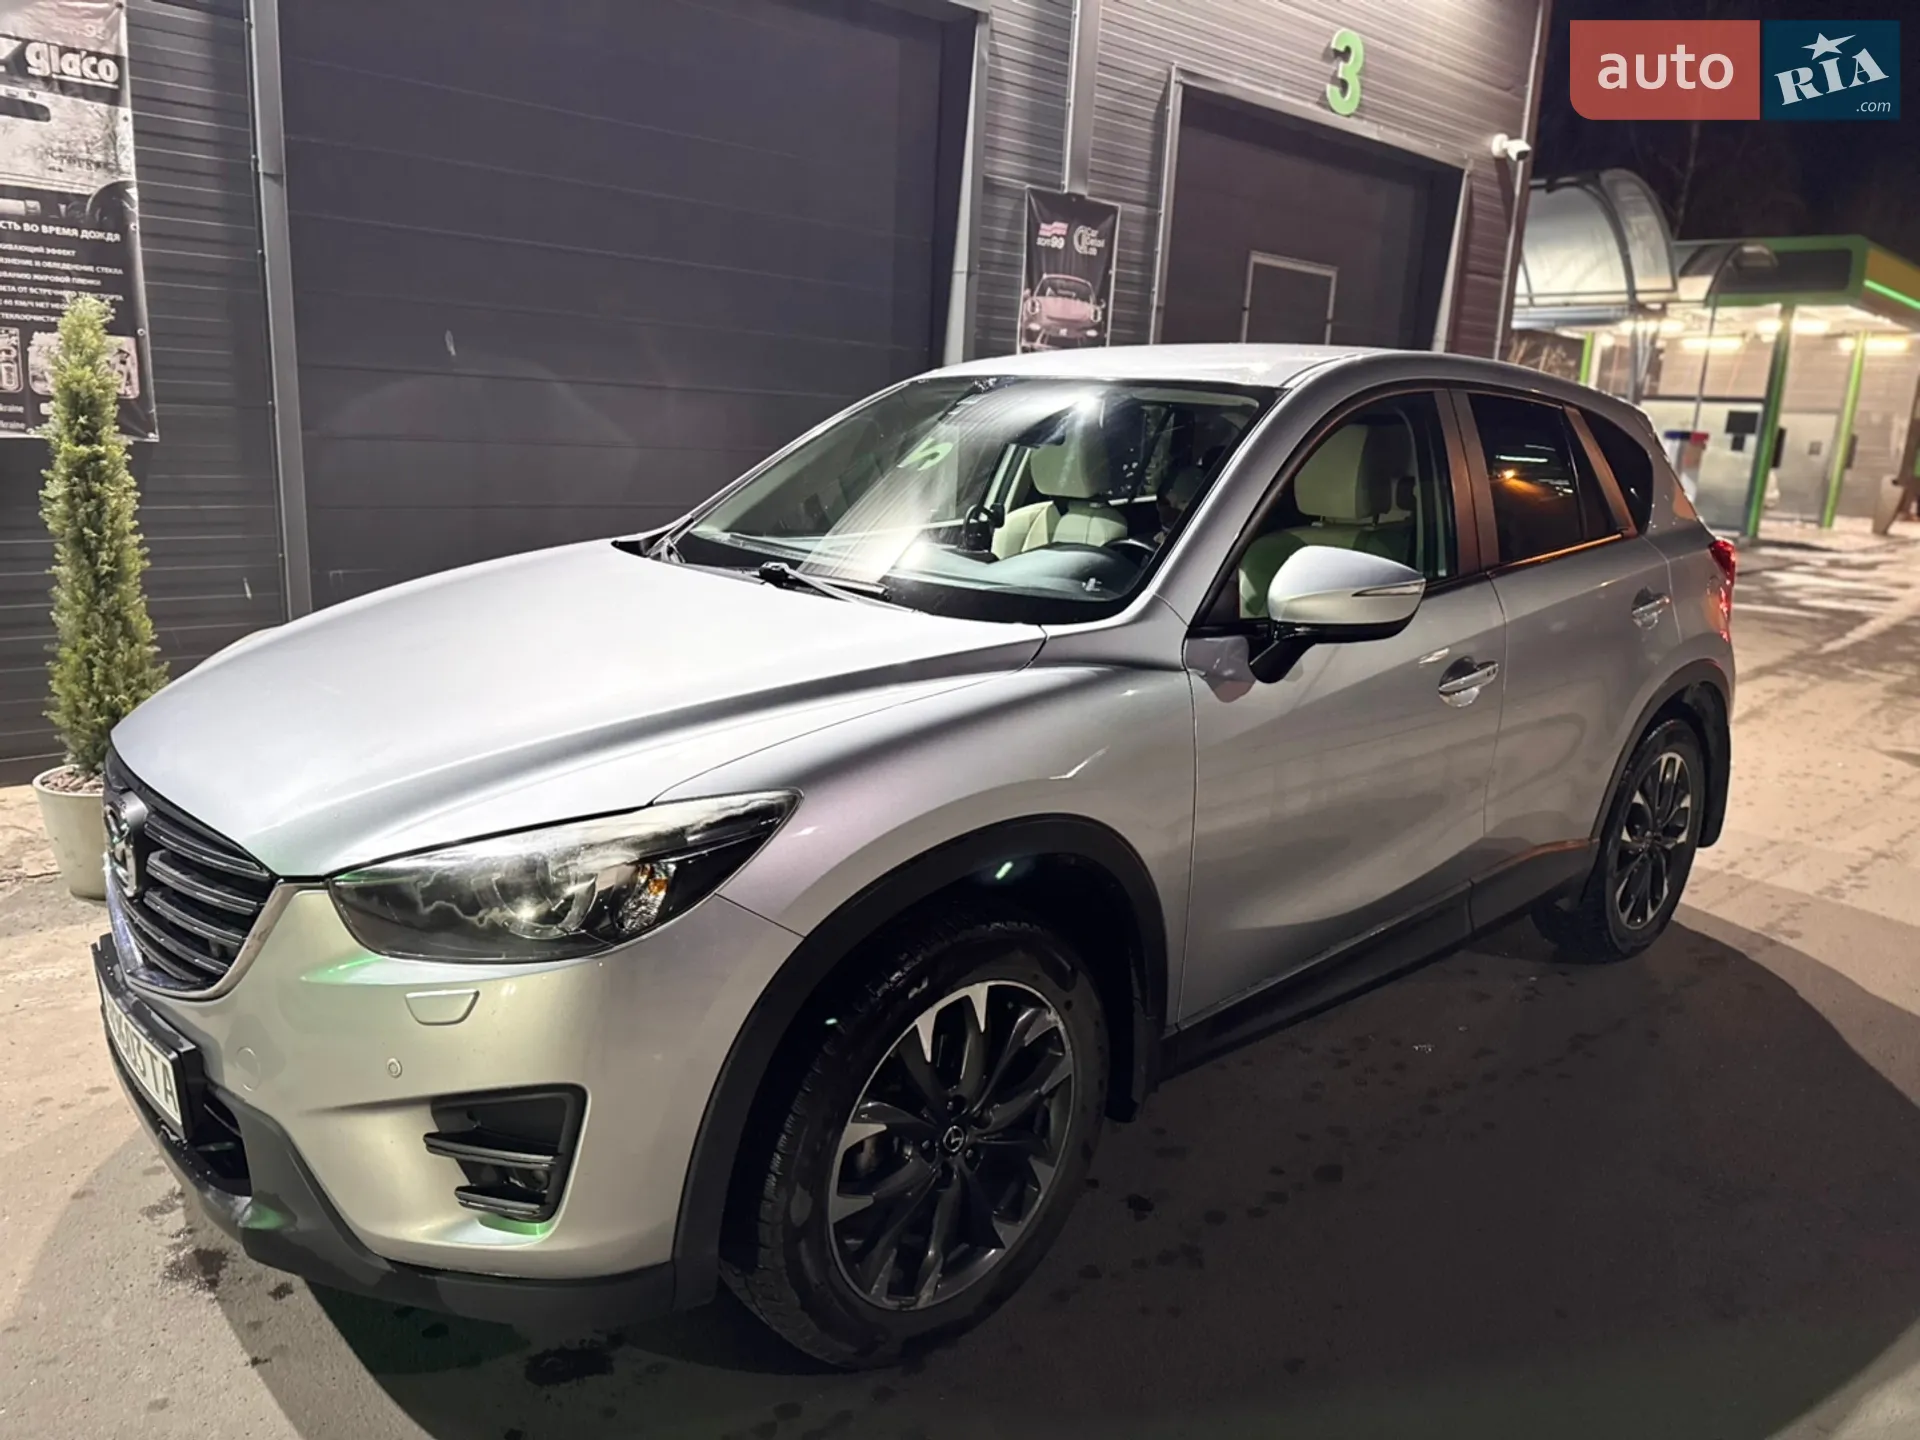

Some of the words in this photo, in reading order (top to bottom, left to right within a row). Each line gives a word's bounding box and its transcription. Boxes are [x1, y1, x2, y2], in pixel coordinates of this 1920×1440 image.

[1326, 28, 1364, 115] 3
[23, 223, 39, 233] ВО
[41, 225, 79, 238] ВРЕМЯ
[80, 229, 121, 242] ДОЖДЯ
